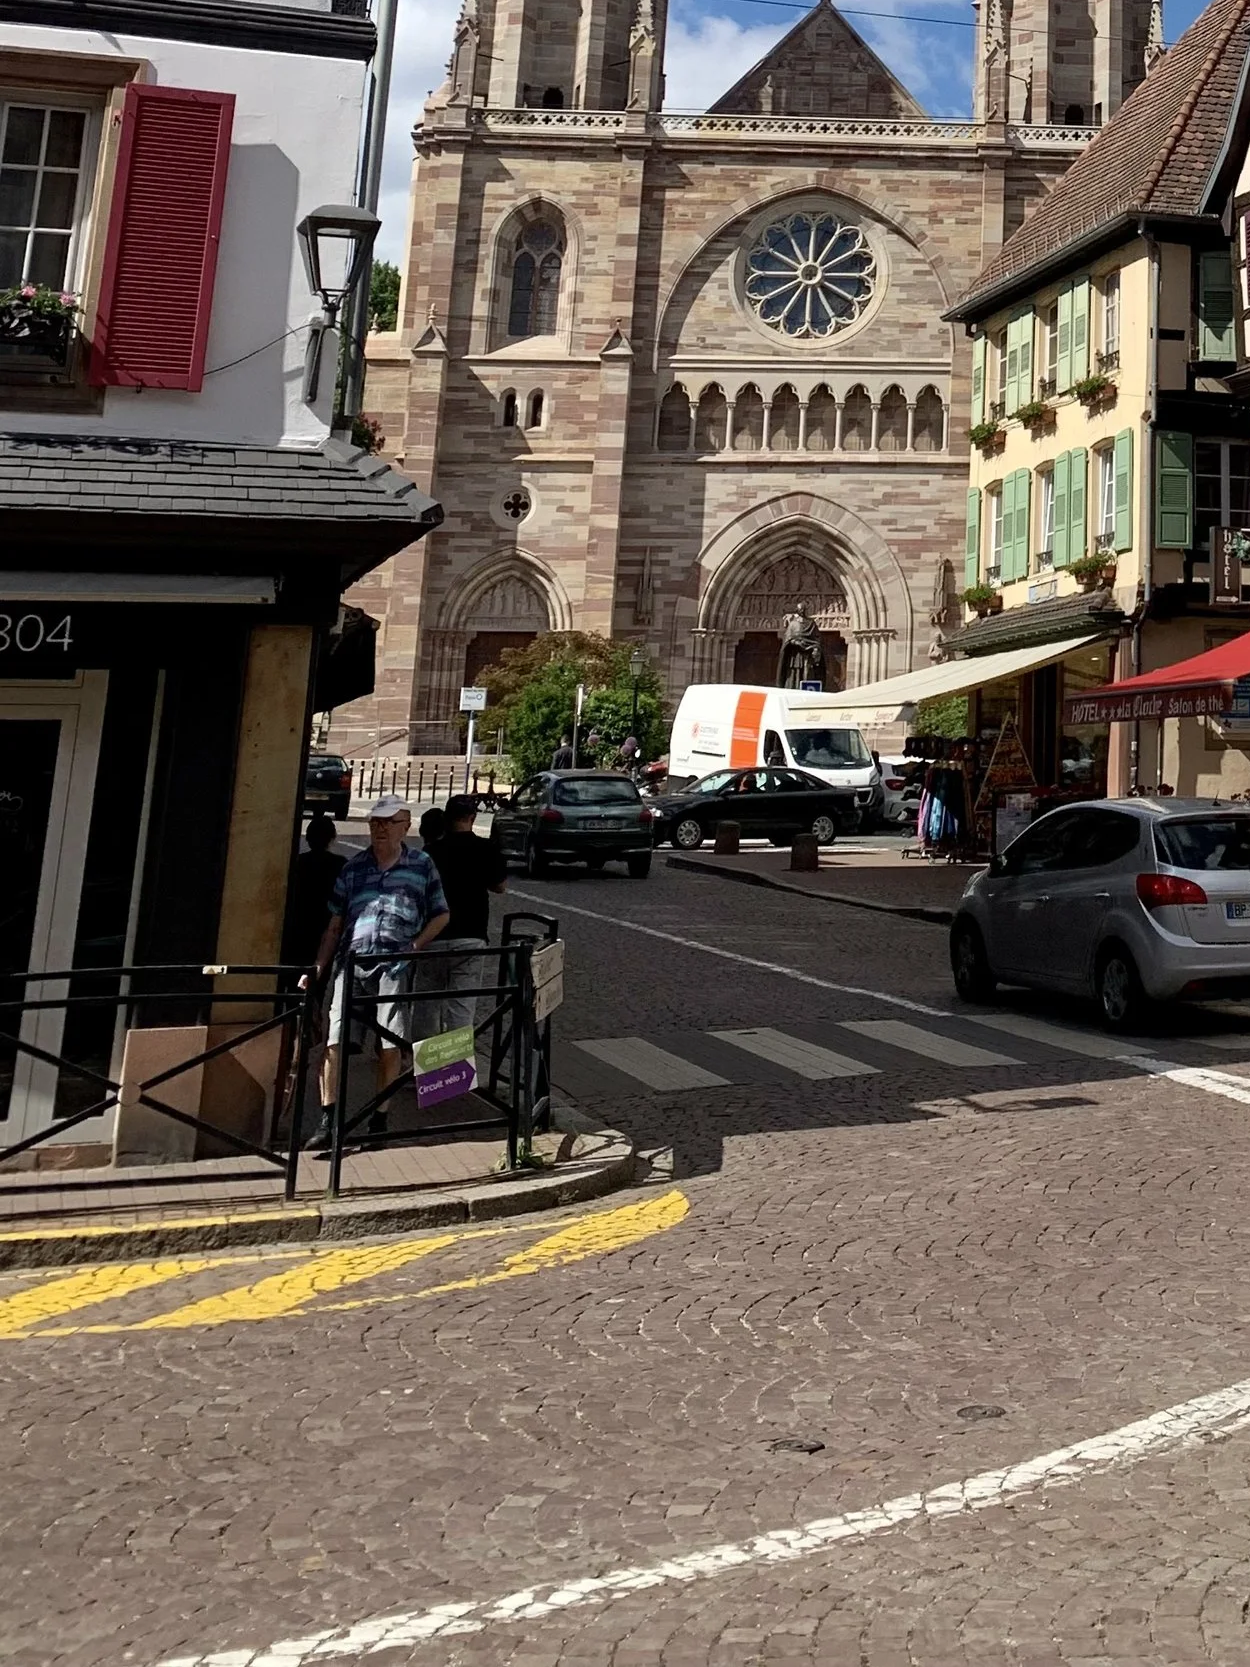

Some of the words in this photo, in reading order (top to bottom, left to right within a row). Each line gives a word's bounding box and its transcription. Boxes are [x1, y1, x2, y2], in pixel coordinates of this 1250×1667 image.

[1168, 697, 1193, 715] Salon
[1195, 697, 1206, 712] de
[418, 1079, 444, 1094] Circuit
[444, 1073, 460, 1086] vélo
